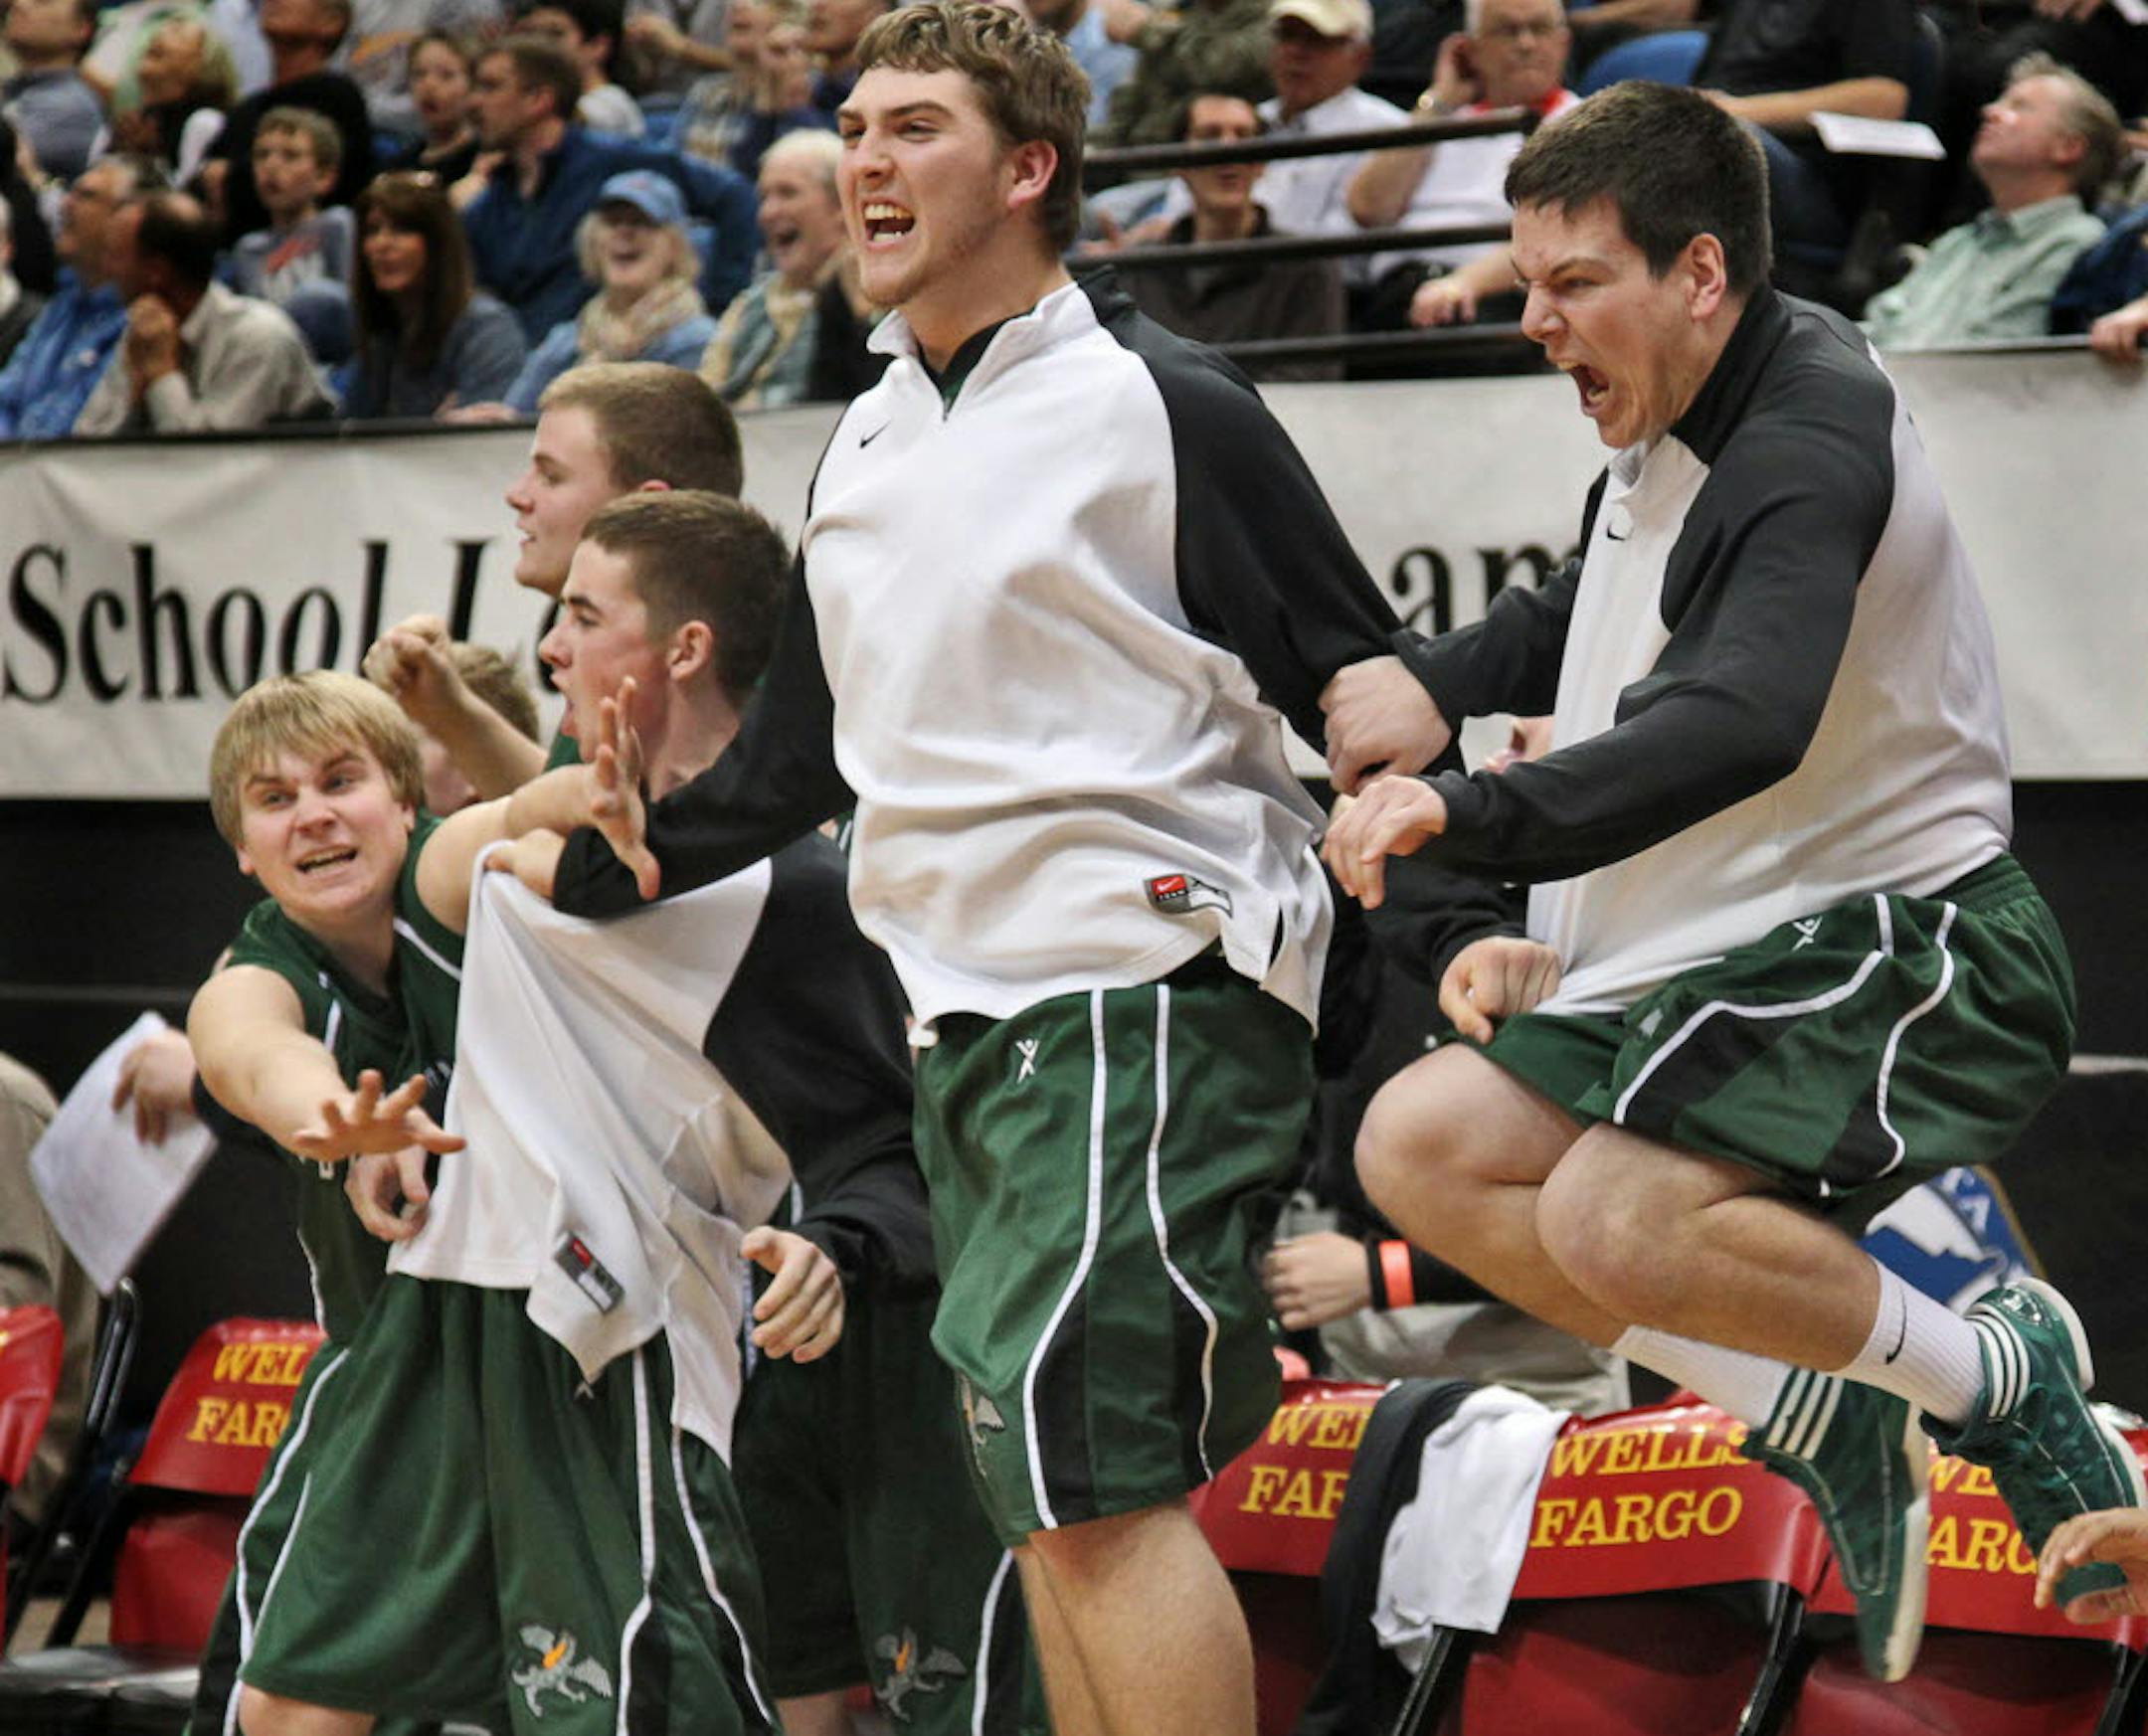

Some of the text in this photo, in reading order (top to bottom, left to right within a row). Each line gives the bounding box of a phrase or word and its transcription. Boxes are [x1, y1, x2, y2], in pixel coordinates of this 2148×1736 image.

[3, 541, 389, 704] School
[186, 1397, 291, 1448] FAR
[1550, 1423, 1750, 1477] WELLS
[1529, 1485, 1743, 1548] FARGO
